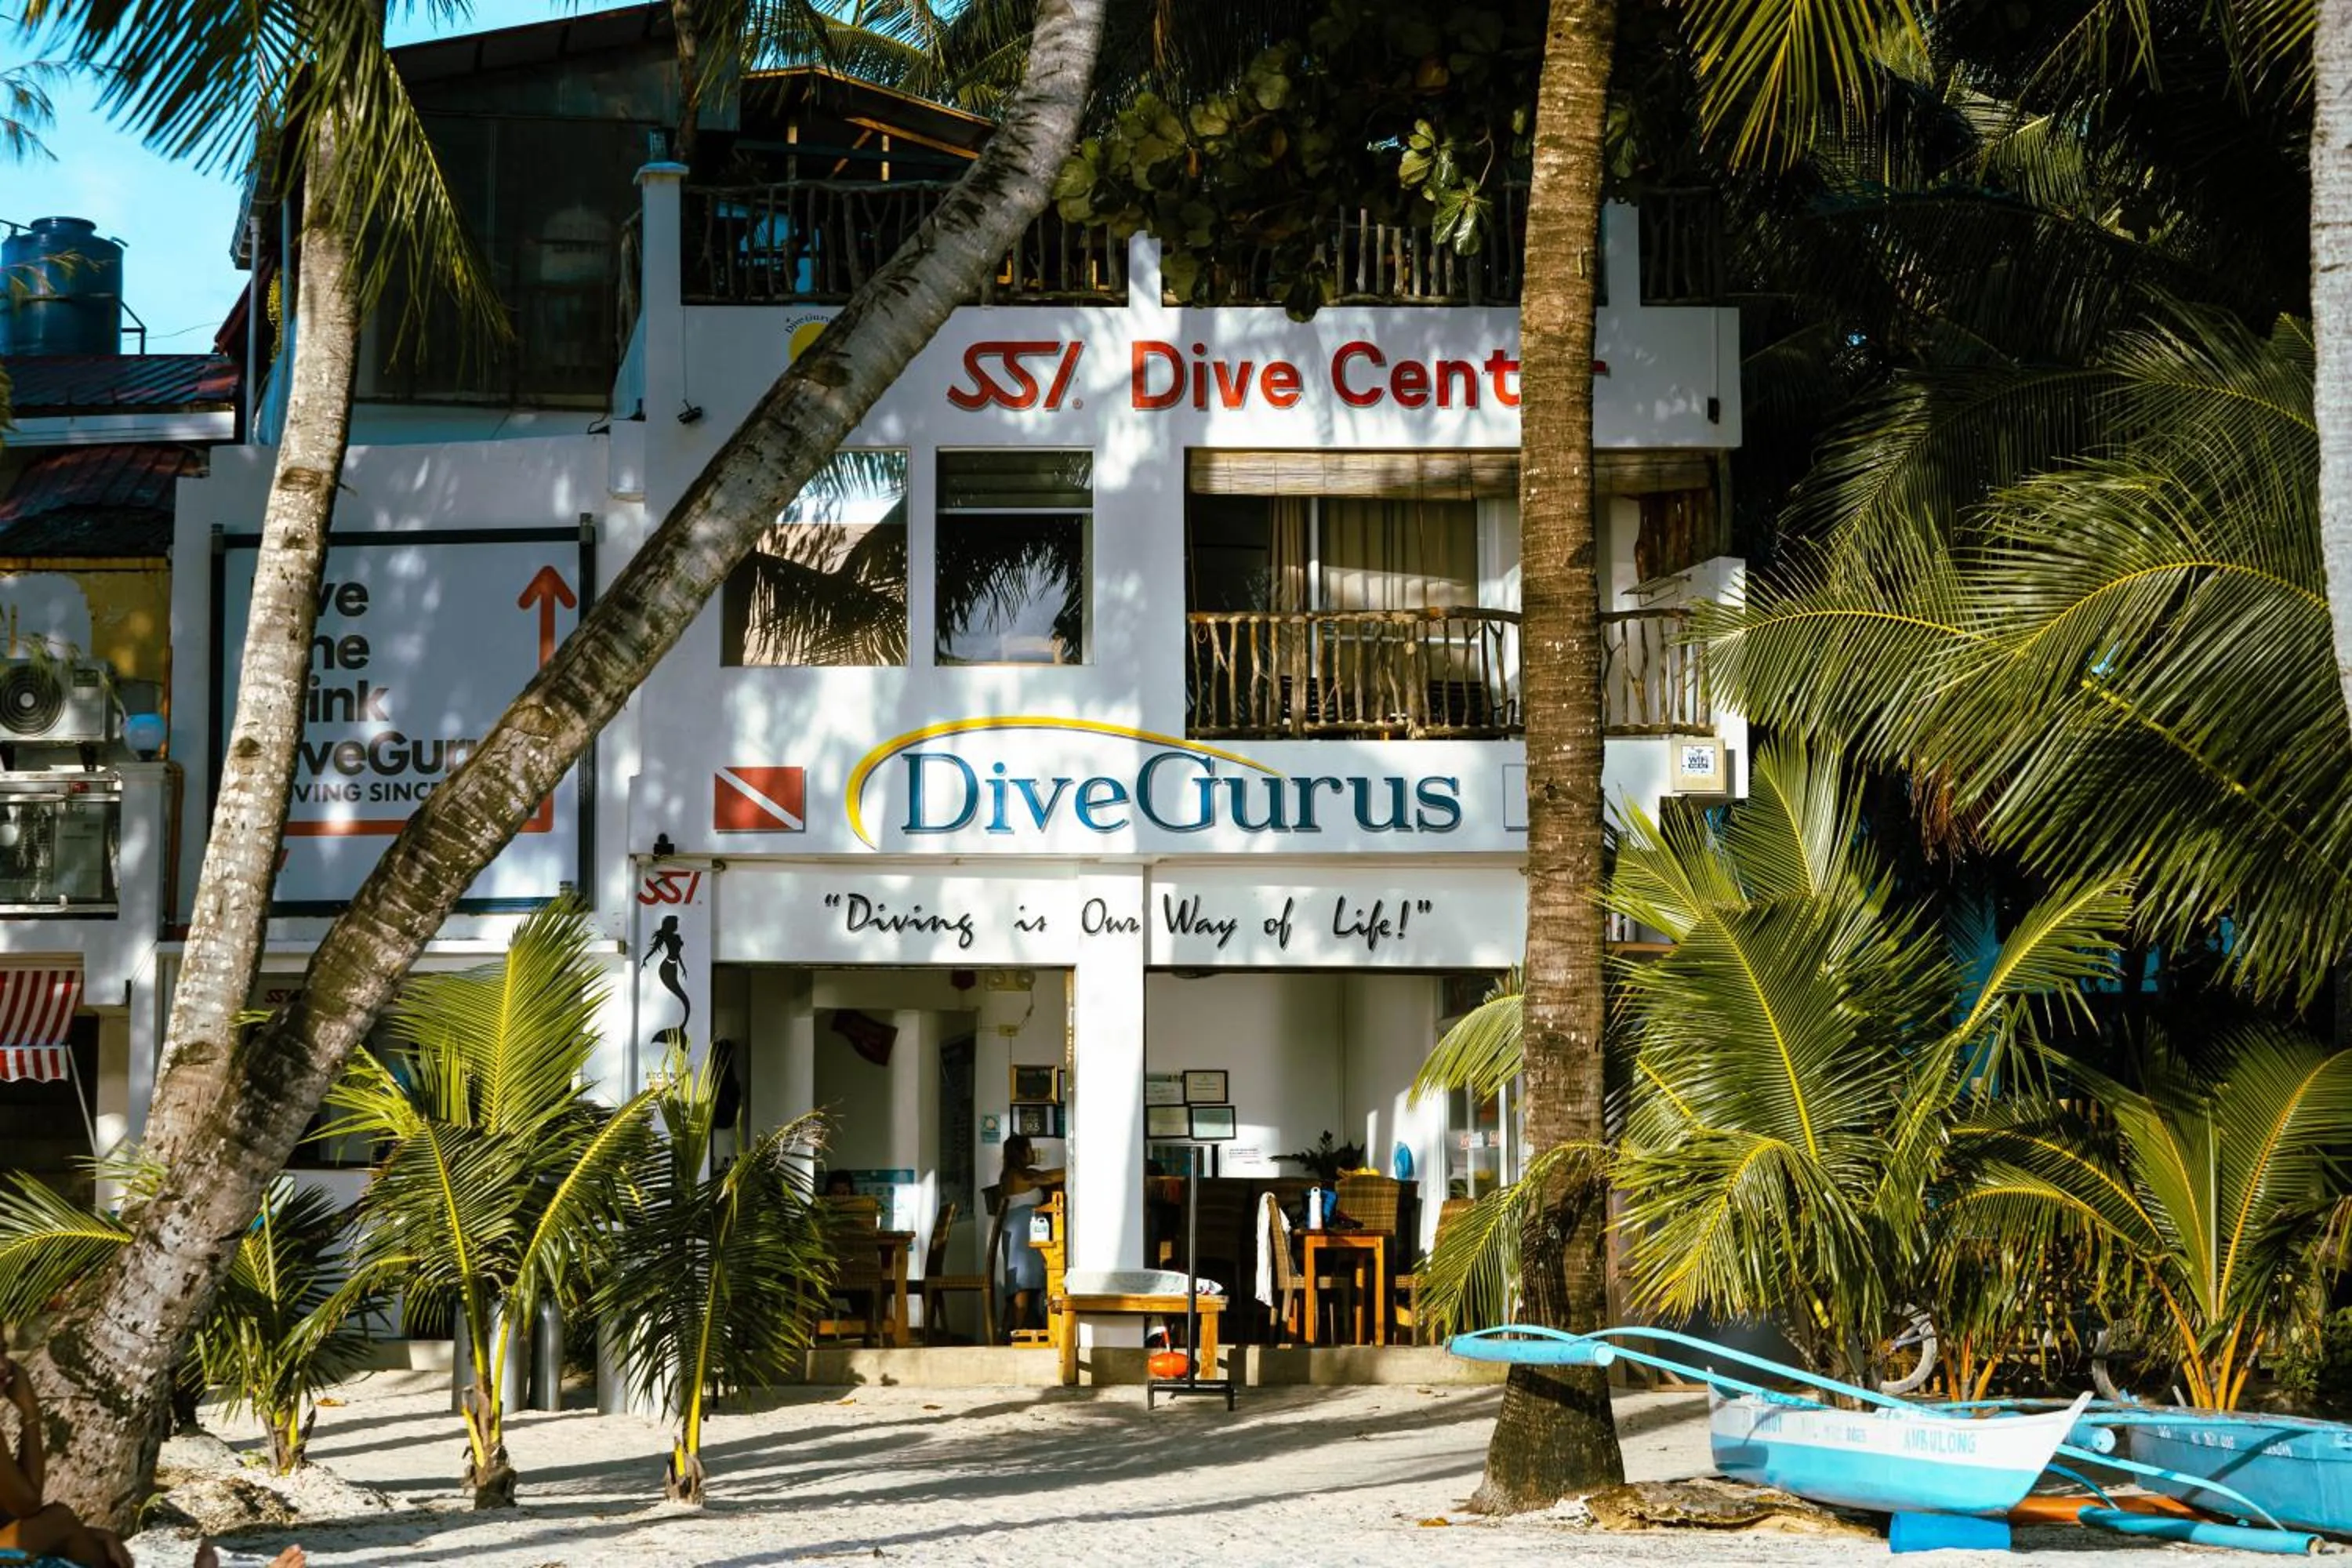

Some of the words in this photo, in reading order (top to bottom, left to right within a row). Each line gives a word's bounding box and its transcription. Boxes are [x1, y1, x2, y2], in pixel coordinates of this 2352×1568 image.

[947, 340, 1083, 410] SSI
[1131, 340, 1301, 411] Dive
[1331, 340, 1611, 408] Cent
[317, 582, 368, 617] ve
[311, 634, 369, 670] ne
[306, 675, 390, 722] ink
[297, 731, 478, 776] veGur
[295, 782, 362, 803] VING
[901, 751, 1464, 835] DiveGurus
[1014, 905, 1048, 934] is
[1080, 897, 1141, 935] Our
[1163, 892, 1240, 951] Way
[1263, 897, 1294, 952] of
